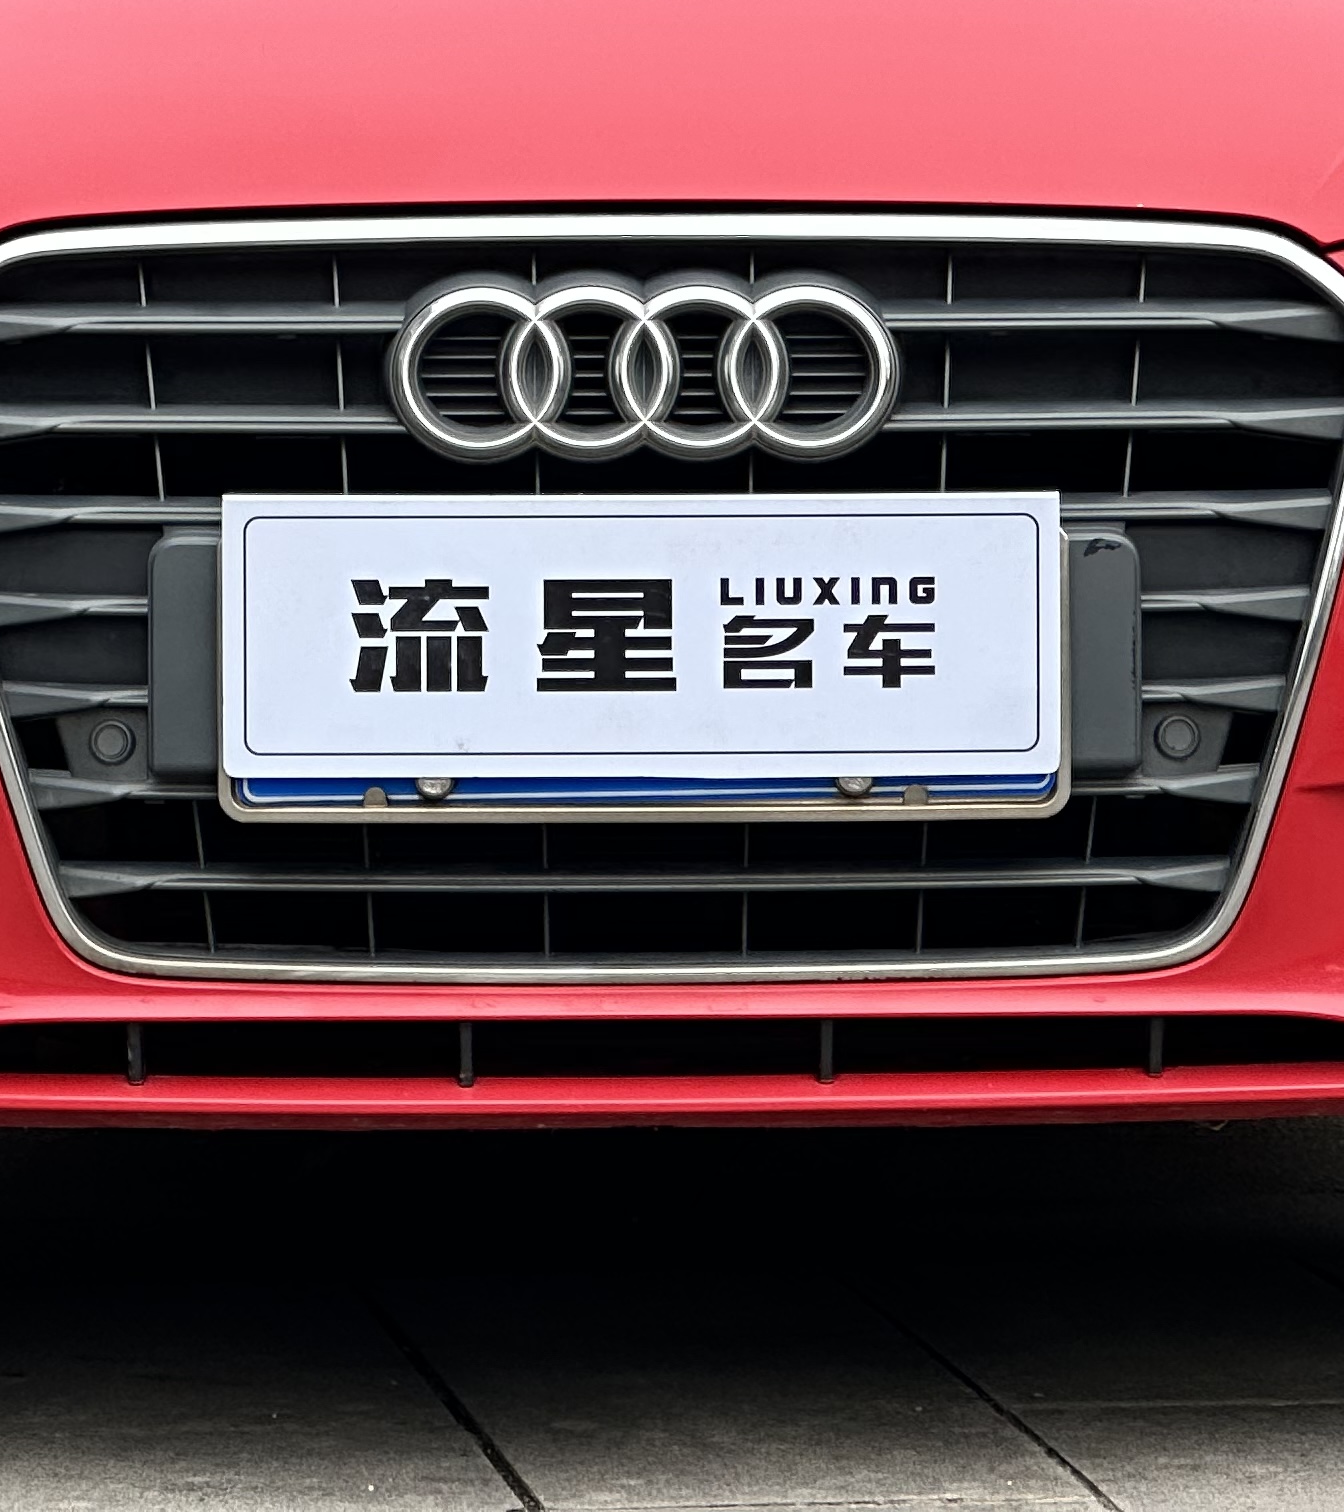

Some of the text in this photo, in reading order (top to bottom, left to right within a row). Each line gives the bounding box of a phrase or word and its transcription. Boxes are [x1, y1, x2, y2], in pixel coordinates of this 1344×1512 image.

[718, 575, 937, 607] LIUXING
[348, 577, 937, 694] 流星 名车
